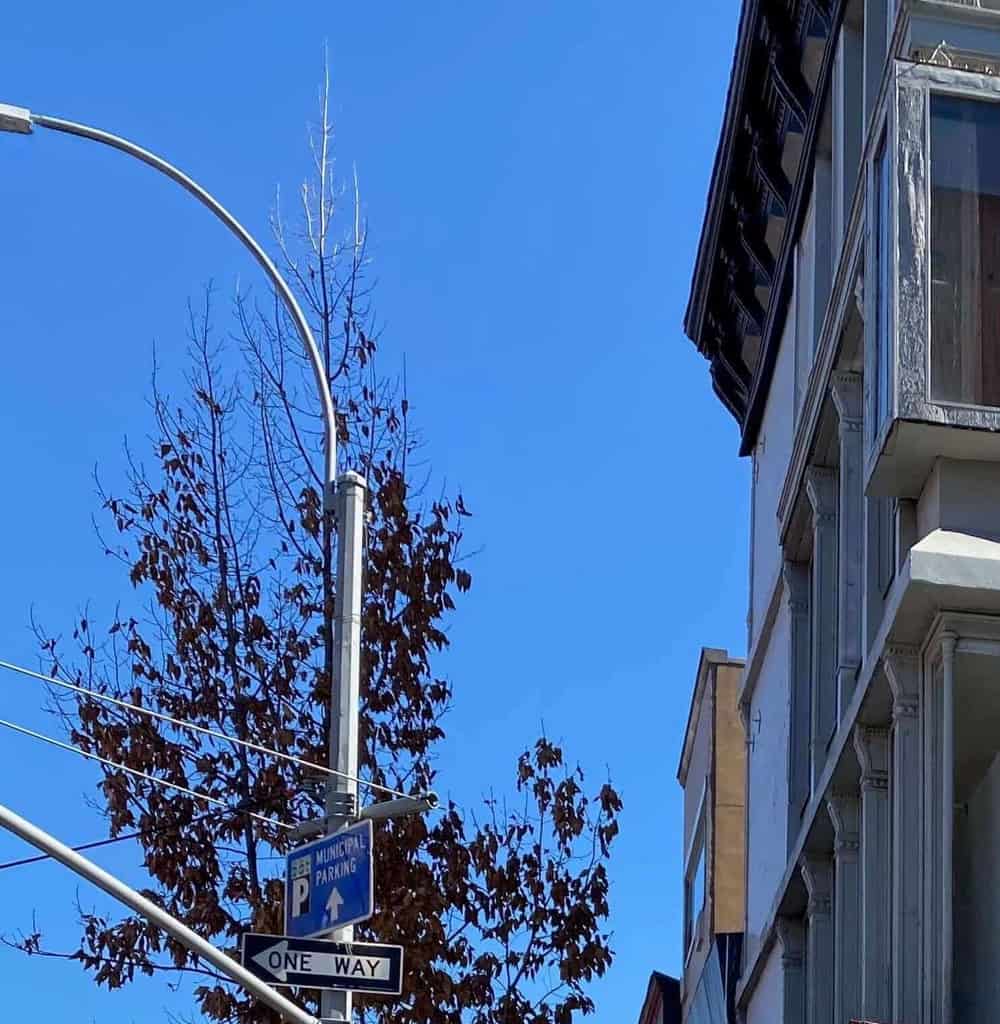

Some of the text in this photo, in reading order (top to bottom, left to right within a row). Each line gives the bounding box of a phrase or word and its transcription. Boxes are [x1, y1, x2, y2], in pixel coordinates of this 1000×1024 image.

[316, 834, 367, 865] MUNICIPAL
[316, 858, 357, 887] PARKING
[291, 877, 310, 919] P
[268, 951, 381, 978] ONE WAY
